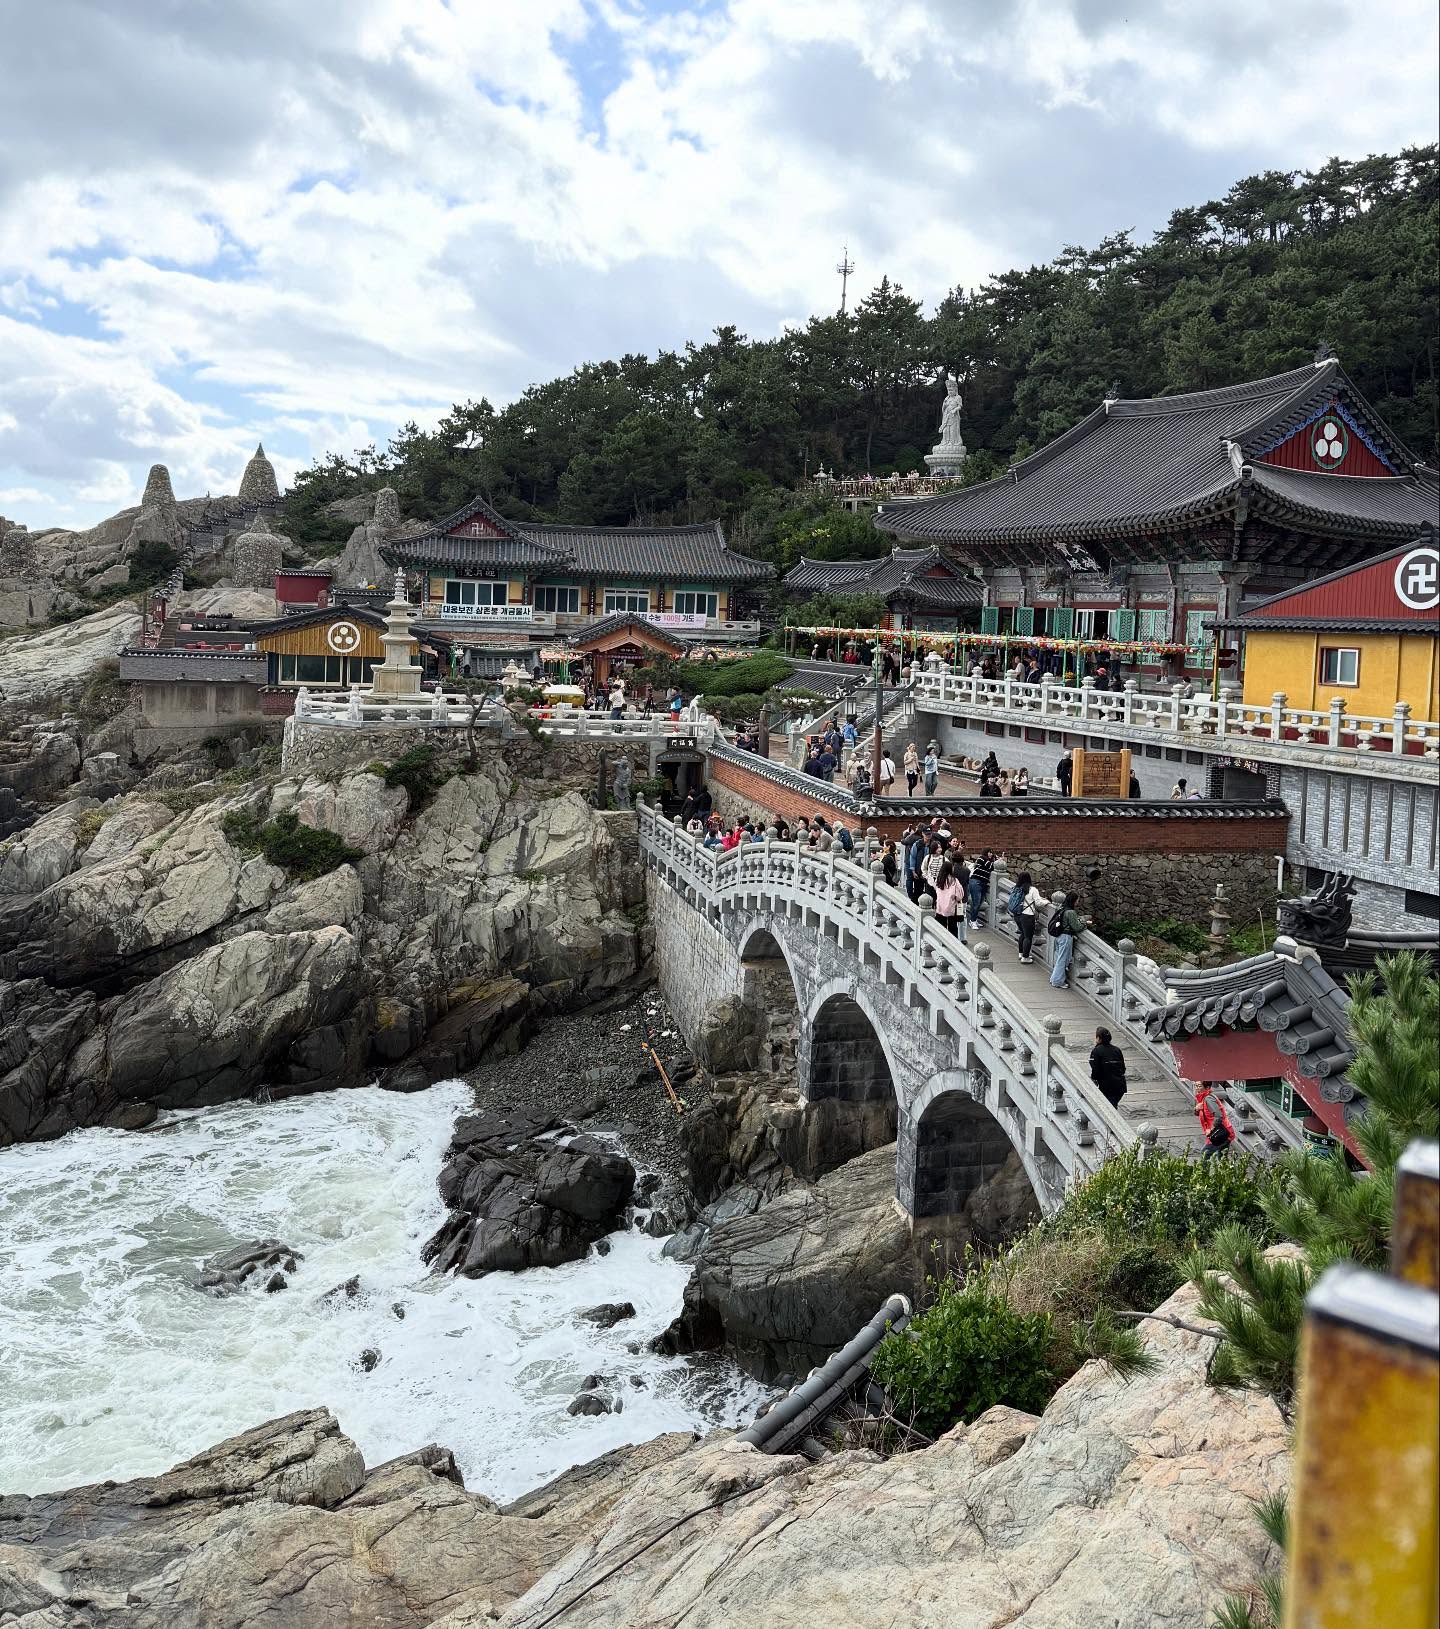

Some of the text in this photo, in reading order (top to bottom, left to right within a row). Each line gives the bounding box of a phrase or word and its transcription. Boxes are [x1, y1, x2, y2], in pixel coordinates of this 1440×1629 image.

[443, 605, 531, 616] 대웅보전 삼존불 개금불사
